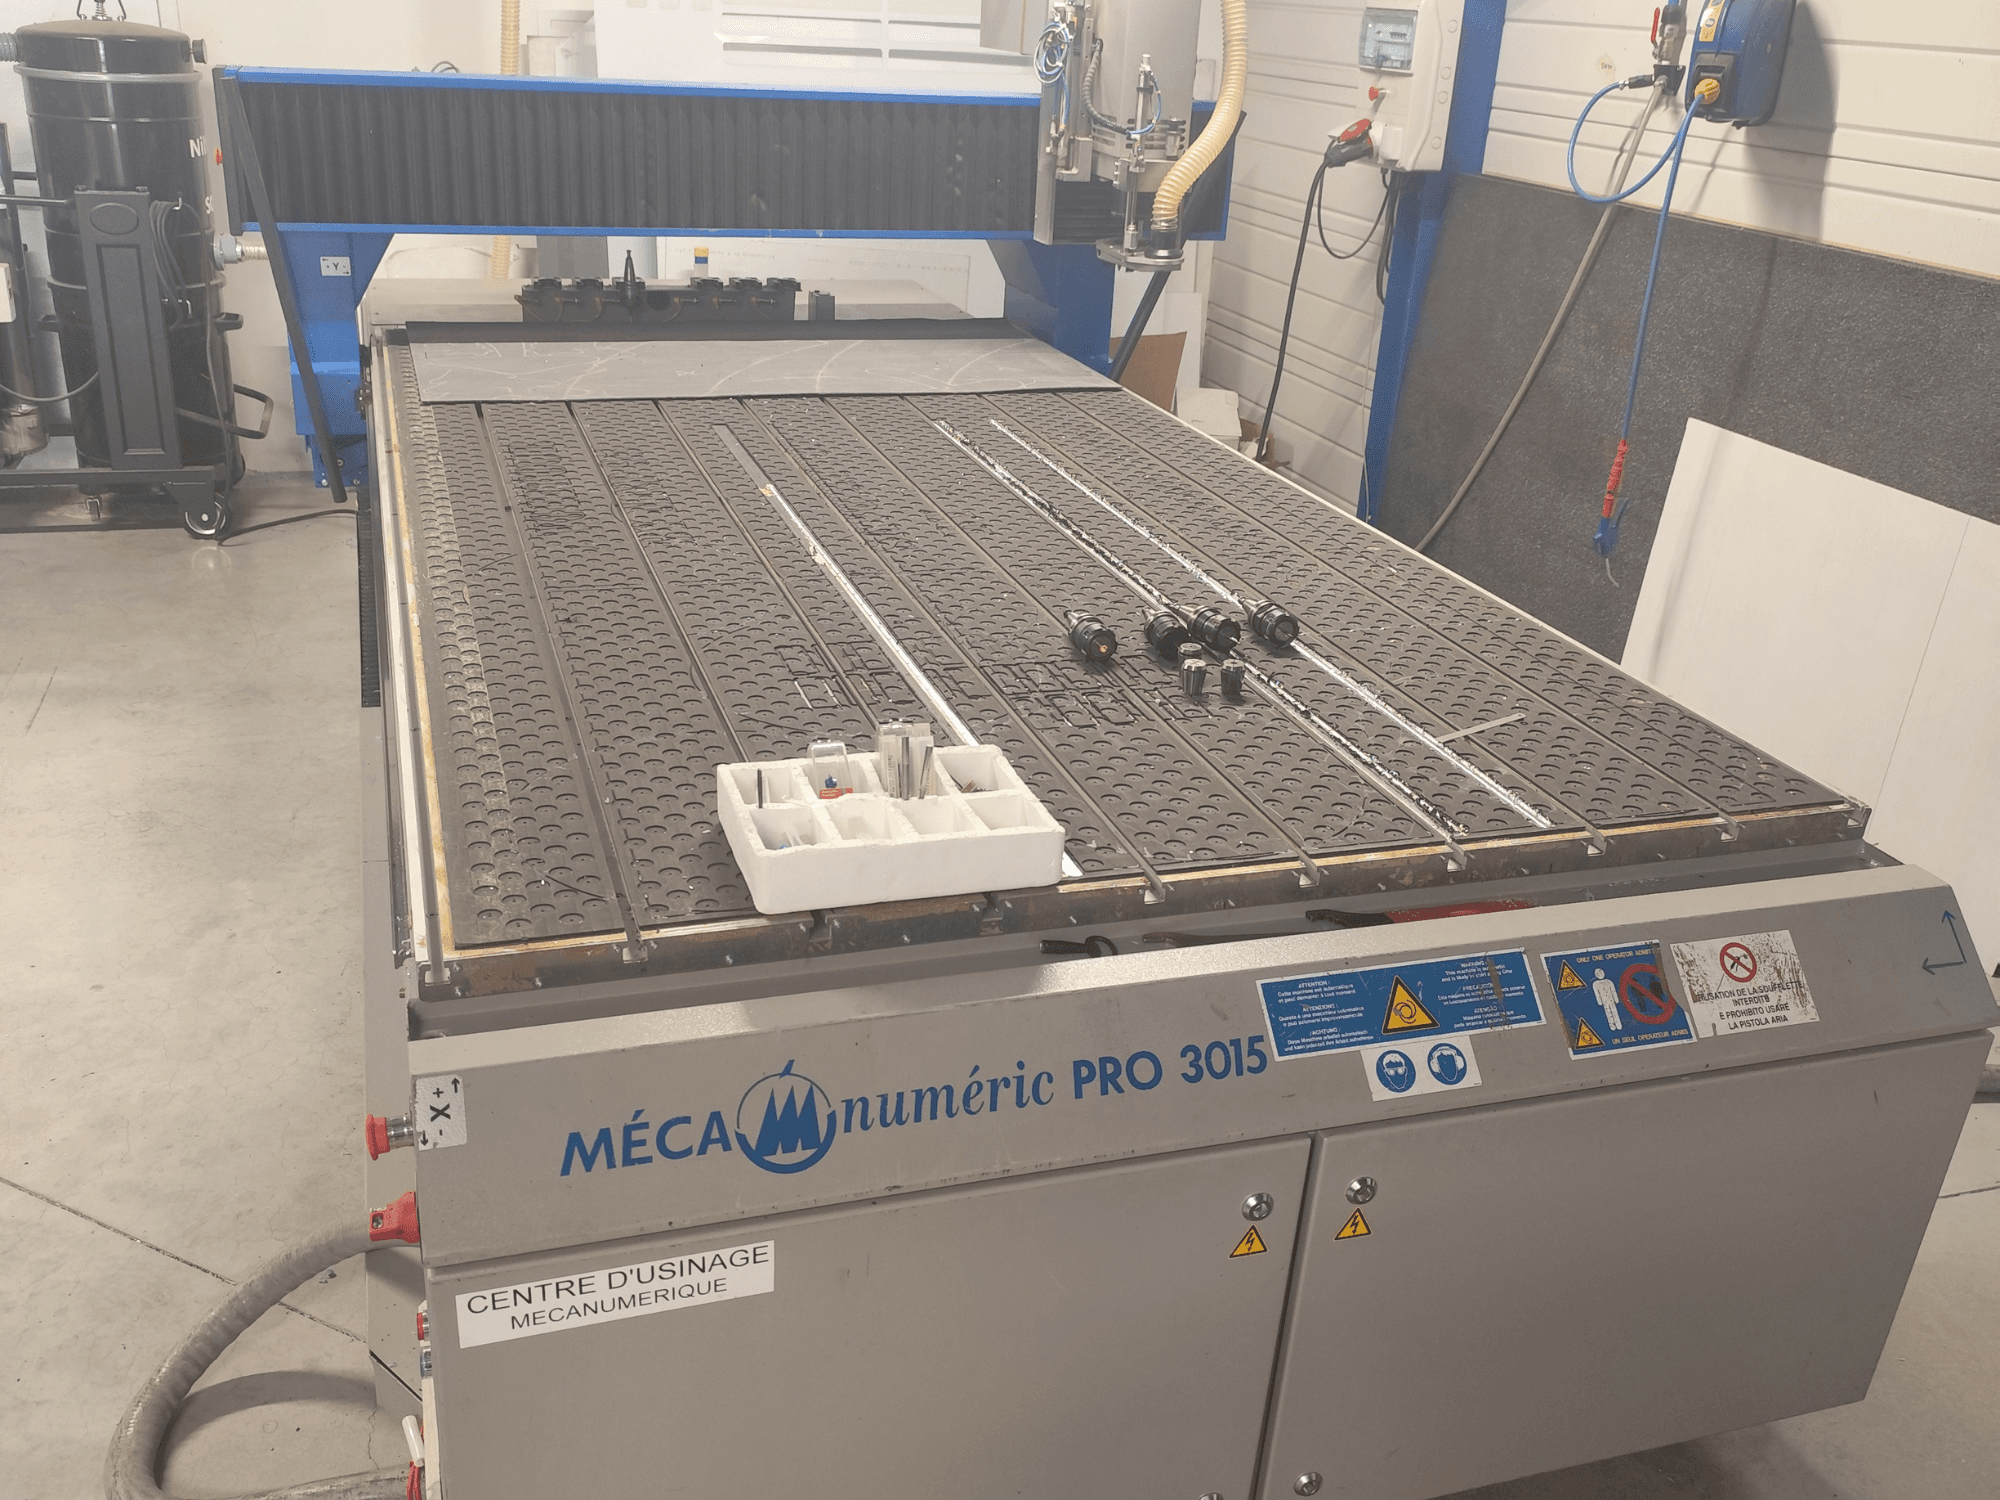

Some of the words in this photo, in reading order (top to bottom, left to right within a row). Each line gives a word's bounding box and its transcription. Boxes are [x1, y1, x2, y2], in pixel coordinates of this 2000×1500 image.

[332, 262, 339, 271] Y
[1576, 956, 1590, 964] ONLY
[1605, 951, 1634, 959] OPERATOR
[1298, 980, 1328, 989] ATTENTION
[1323, 983, 1354, 993] automatique
[1695, 990, 1736, 1002] TILISATION
[1736, 988, 1747, 997] DE
[1747, 985, 1759, 995] LA
[1758, 980, 1804, 993] SOUFFLETTE
[1726, 1006, 1765, 1019] PROHIBITO
[1766, 1003, 1790, 1014] USARE
[1728, 1021, 1739, 1030] LA
[1740, 1017, 1769, 1028] PISTOLA
[1771, 1014, 1789, 1024] ARIA
[1311, 1027, 1338, 1036] ACHTUNG
[1637, 1031, 1670, 1041] OPERATEUR
[1671, 1028, 1689, 1036] ADMIS
[429, 1103, 451, 1122] X
[560, 1109, 732, 1177] MÉCA
[841, 1060, 1054, 1134] numéric
[1072, 1050, 1163, 1100] PRO
[1180, 1035, 1268, 1084] 3015
[467, 1275, 596, 1314] CENTRE
[607, 1244, 770, 1290] D'USINAGE
[511, 1277, 728, 1330] MECANUMERIQUE
